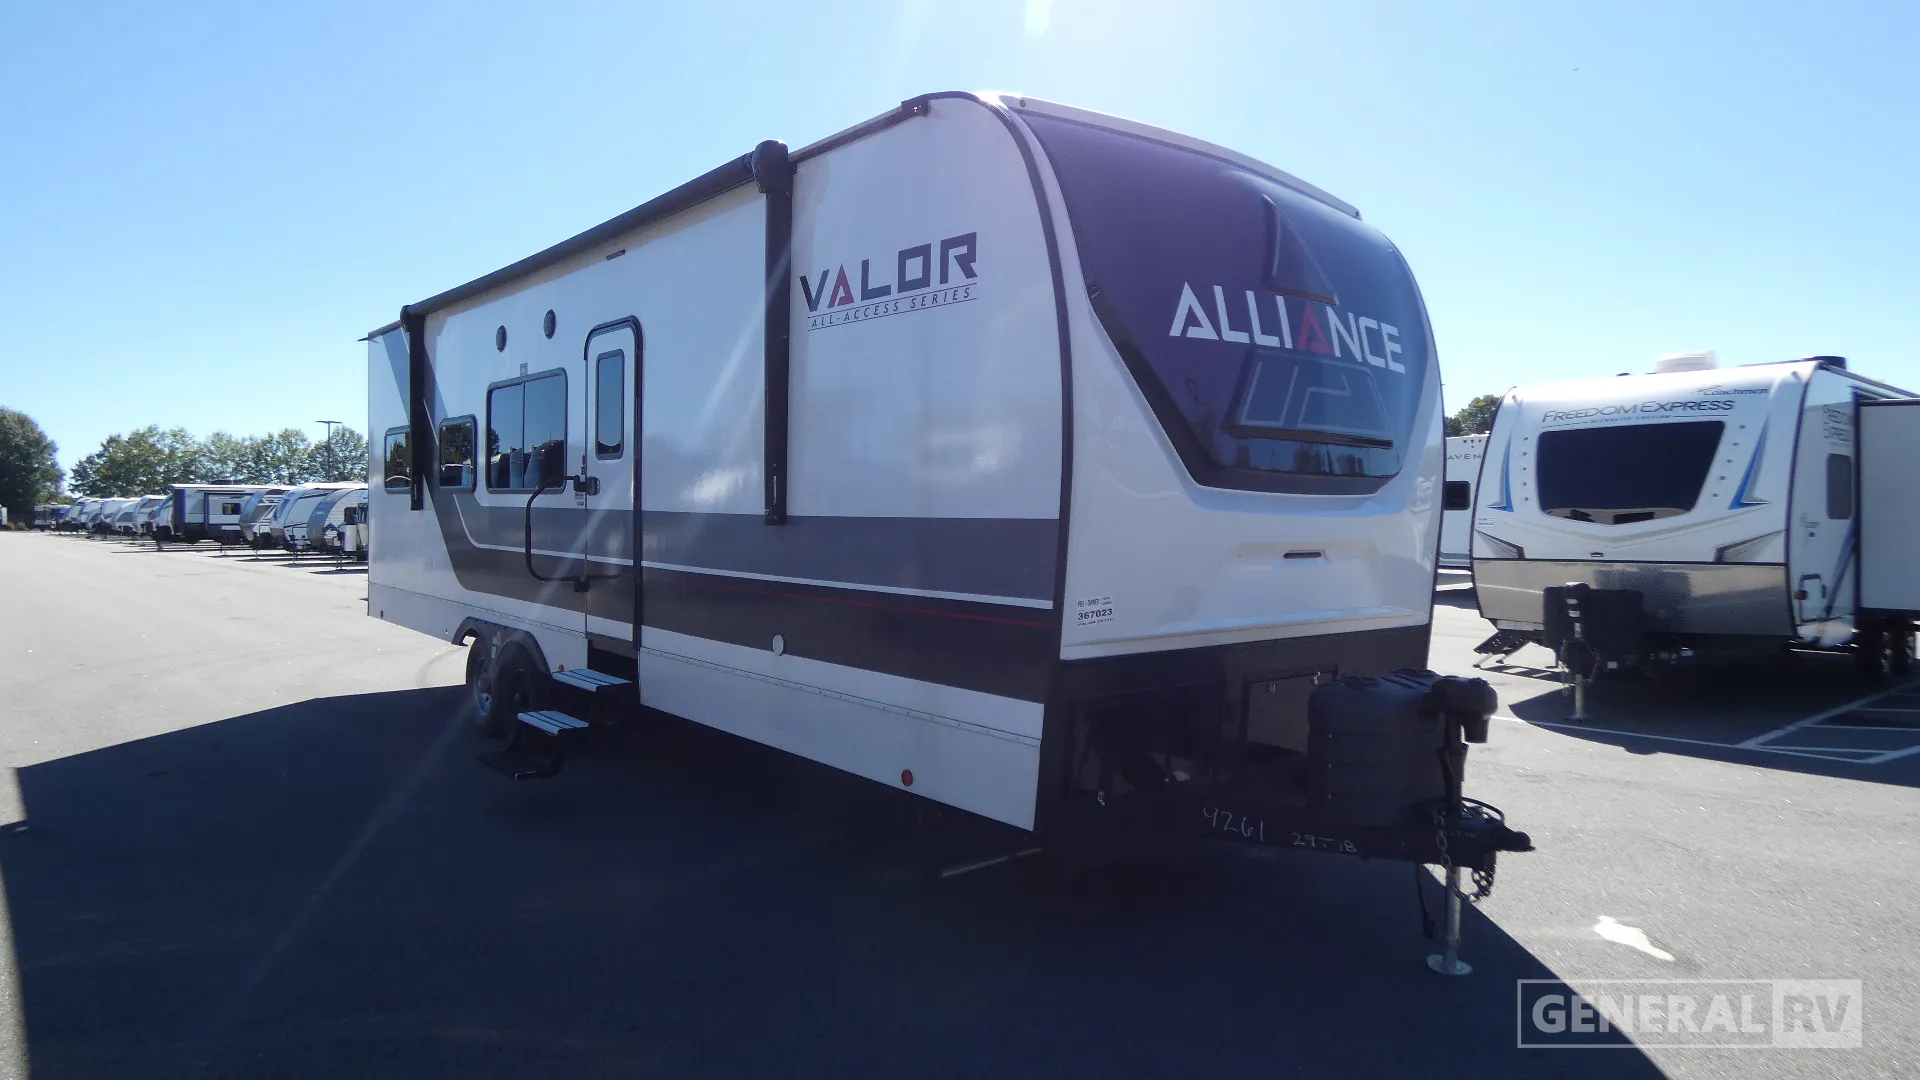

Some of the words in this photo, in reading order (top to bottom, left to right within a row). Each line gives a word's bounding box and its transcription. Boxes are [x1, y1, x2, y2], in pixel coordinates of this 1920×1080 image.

[799, 232, 978, 313] VALOR
[811, 302, 900, 328] ALL-ACCESS
[910, 287, 972, 309] SERIES
[1169, 281, 1406, 374] ALLIANCE
[1701, 387, 1769, 397] Coachmen
[1541, 404, 1638, 423] FREEDOM
[1639, 400, 1736, 413] EXPRESS
[1078, 608, 1113, 620] 367023
